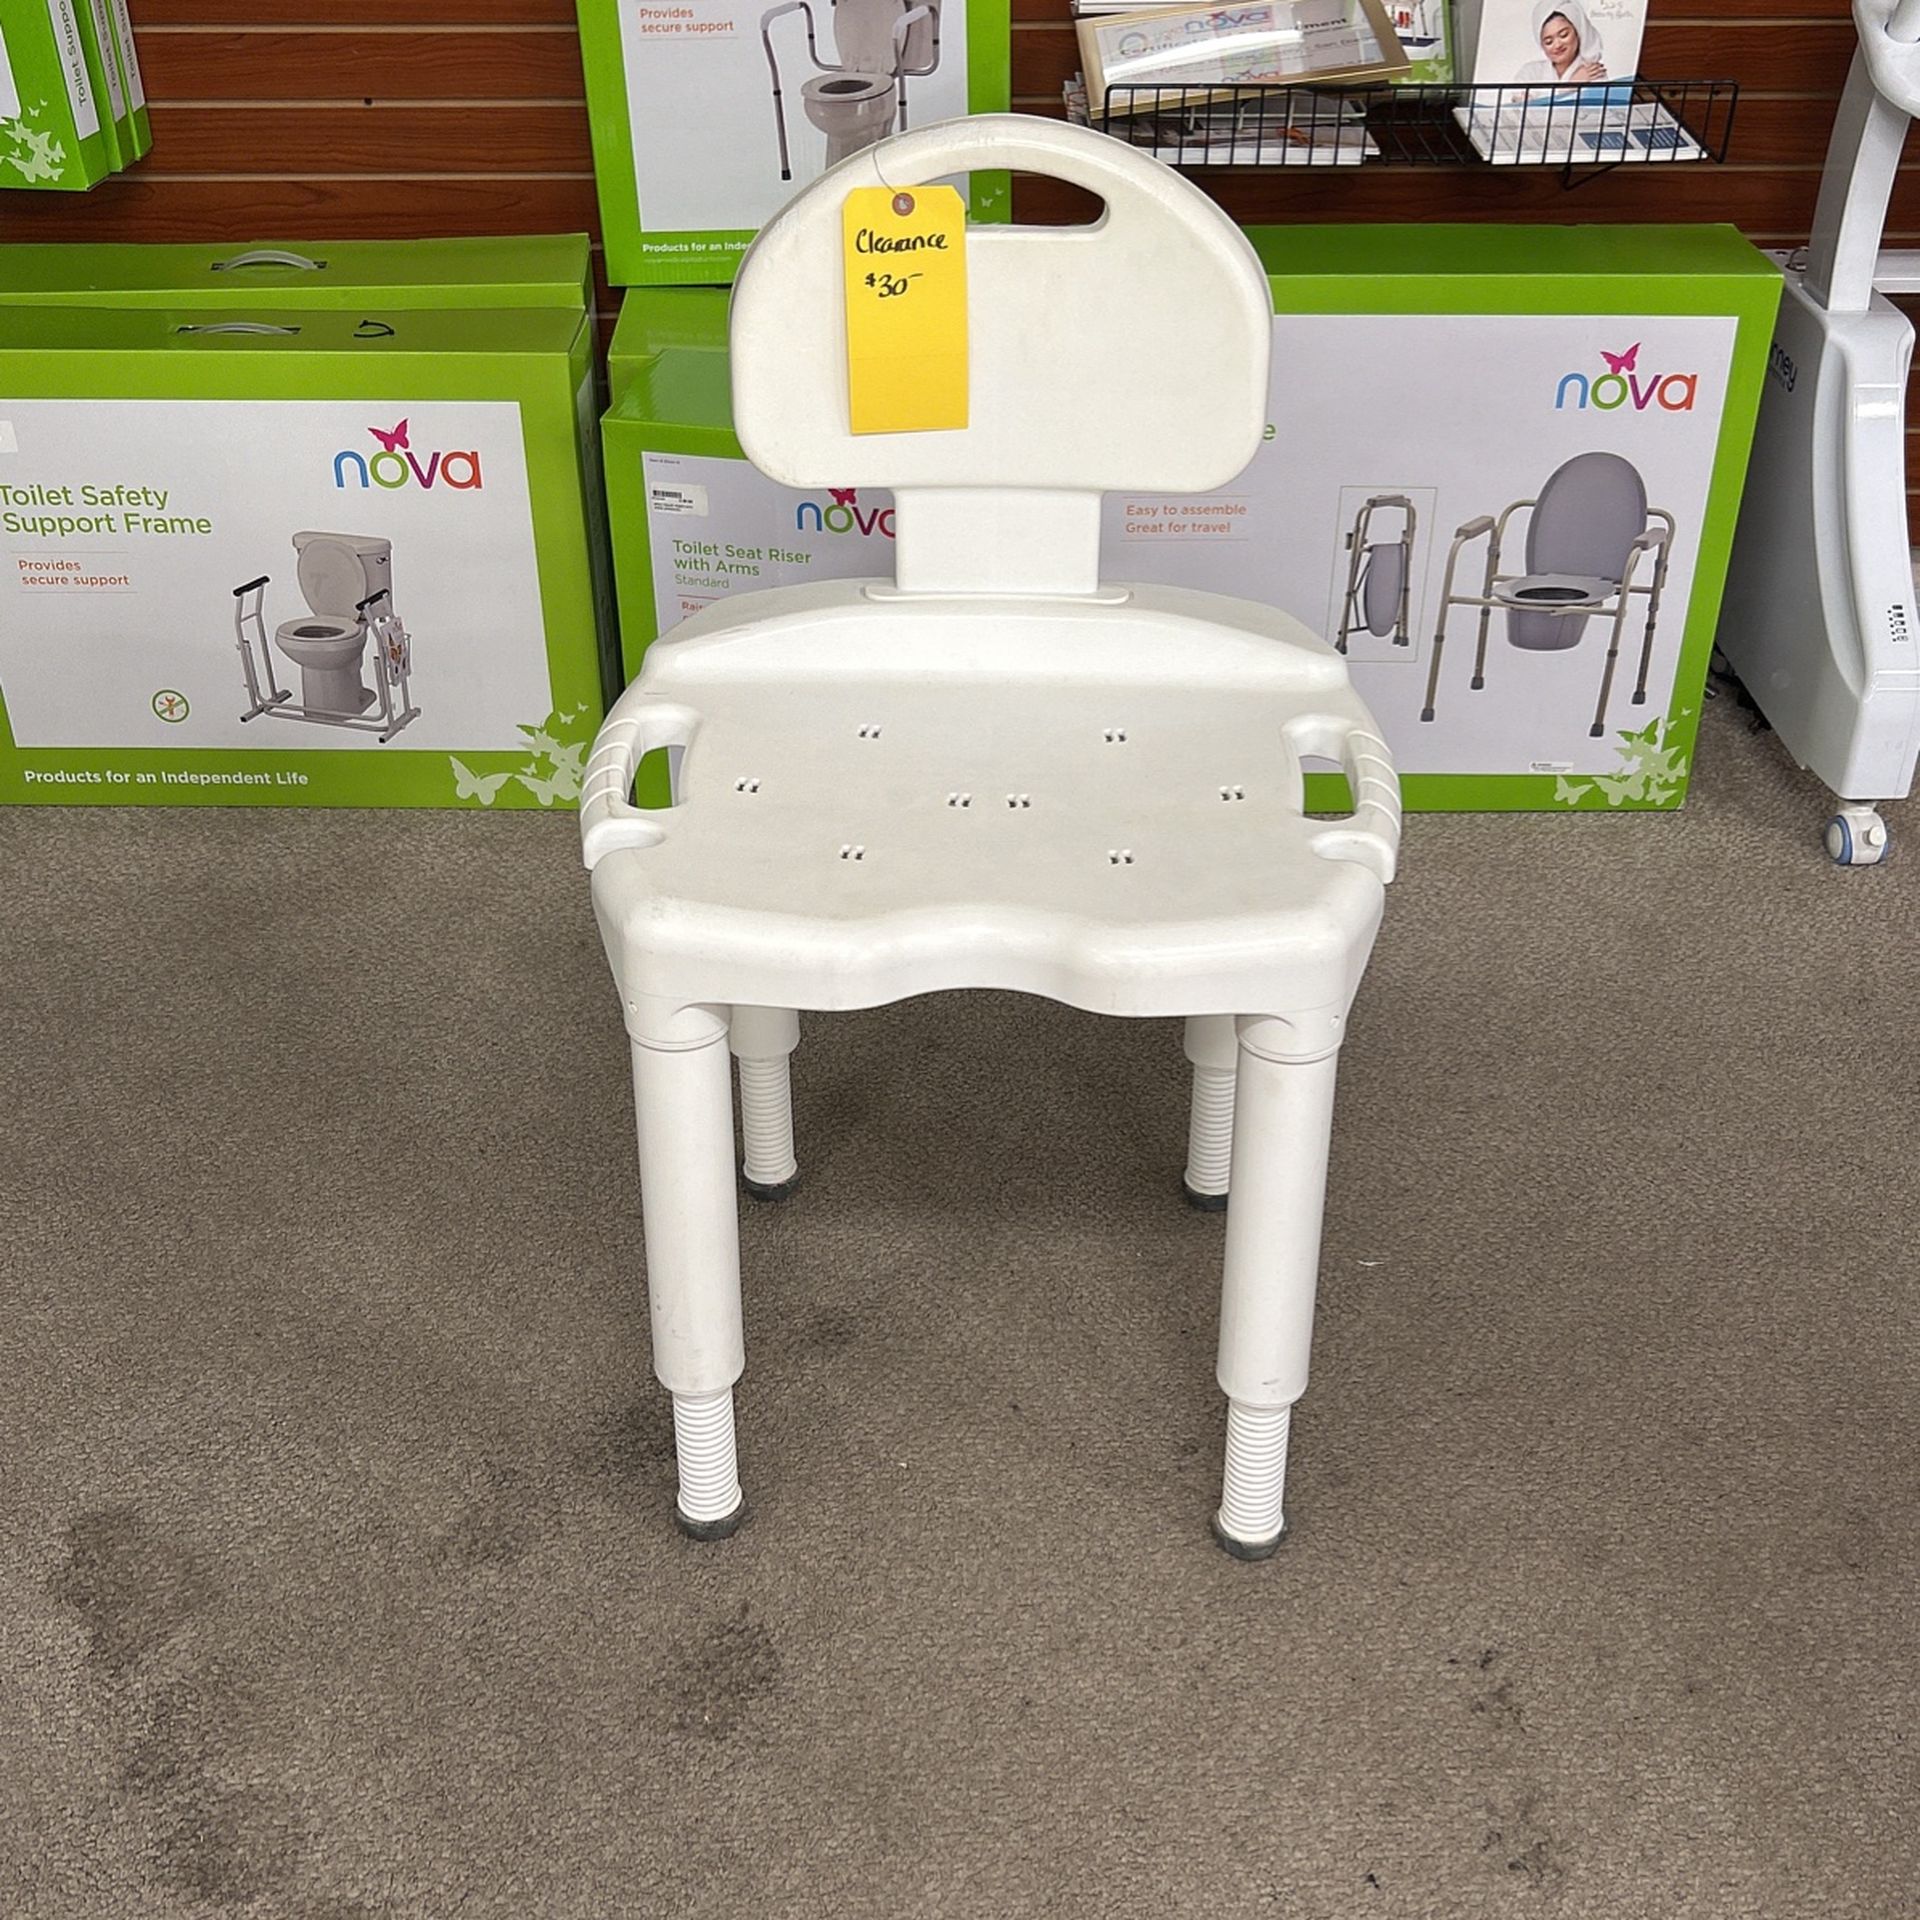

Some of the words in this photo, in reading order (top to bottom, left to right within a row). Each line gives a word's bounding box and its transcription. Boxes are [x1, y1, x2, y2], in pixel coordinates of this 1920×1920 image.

[640, 7, 694, 18] Provides
[641, 22, 682, 33] secure
[686, 20, 734, 33] support
[71, 60, 87, 107] Toilet
[643, 243, 689, 252] Products
[691, 242, 706, 251] for
[709, 243, 722, 251] an
[856, 228, 948, 253] Clearance
[1555, 372, 1698, 411] nova
[333, 450, 483, 490] nova
[0, 484, 74, 506] Toilet
[81, 484, 168, 510] Safety
[1126, 504, 1158, 516] Easy
[1163, 505, 1178, 515] to
[1181, 504, 1247, 515] assemble
[3, 512, 117, 537] Support
[123, 512, 212, 534] Frame
[1125, 522, 1163, 533] Great
[1168, 522, 1186, 533] for
[1191, 522, 1231, 533] travel
[672, 539, 719, 556] Toilet
[725, 544, 763, 560] Seat
[768, 548, 812, 564] Riser
[18, 559, 82, 571] Provides
[674, 558, 710, 572] with
[716, 560, 760, 576] Arms
[22, 575, 69, 585] secure
[73, 574, 130, 587] support
[675, 574, 730, 589] Standard
[24, 770, 101, 783] Products
[106, 769, 131, 783] for
[136, 772, 157, 783] an
[161, 771, 271, 786] Independent
[277, 771, 309, 785] Life
